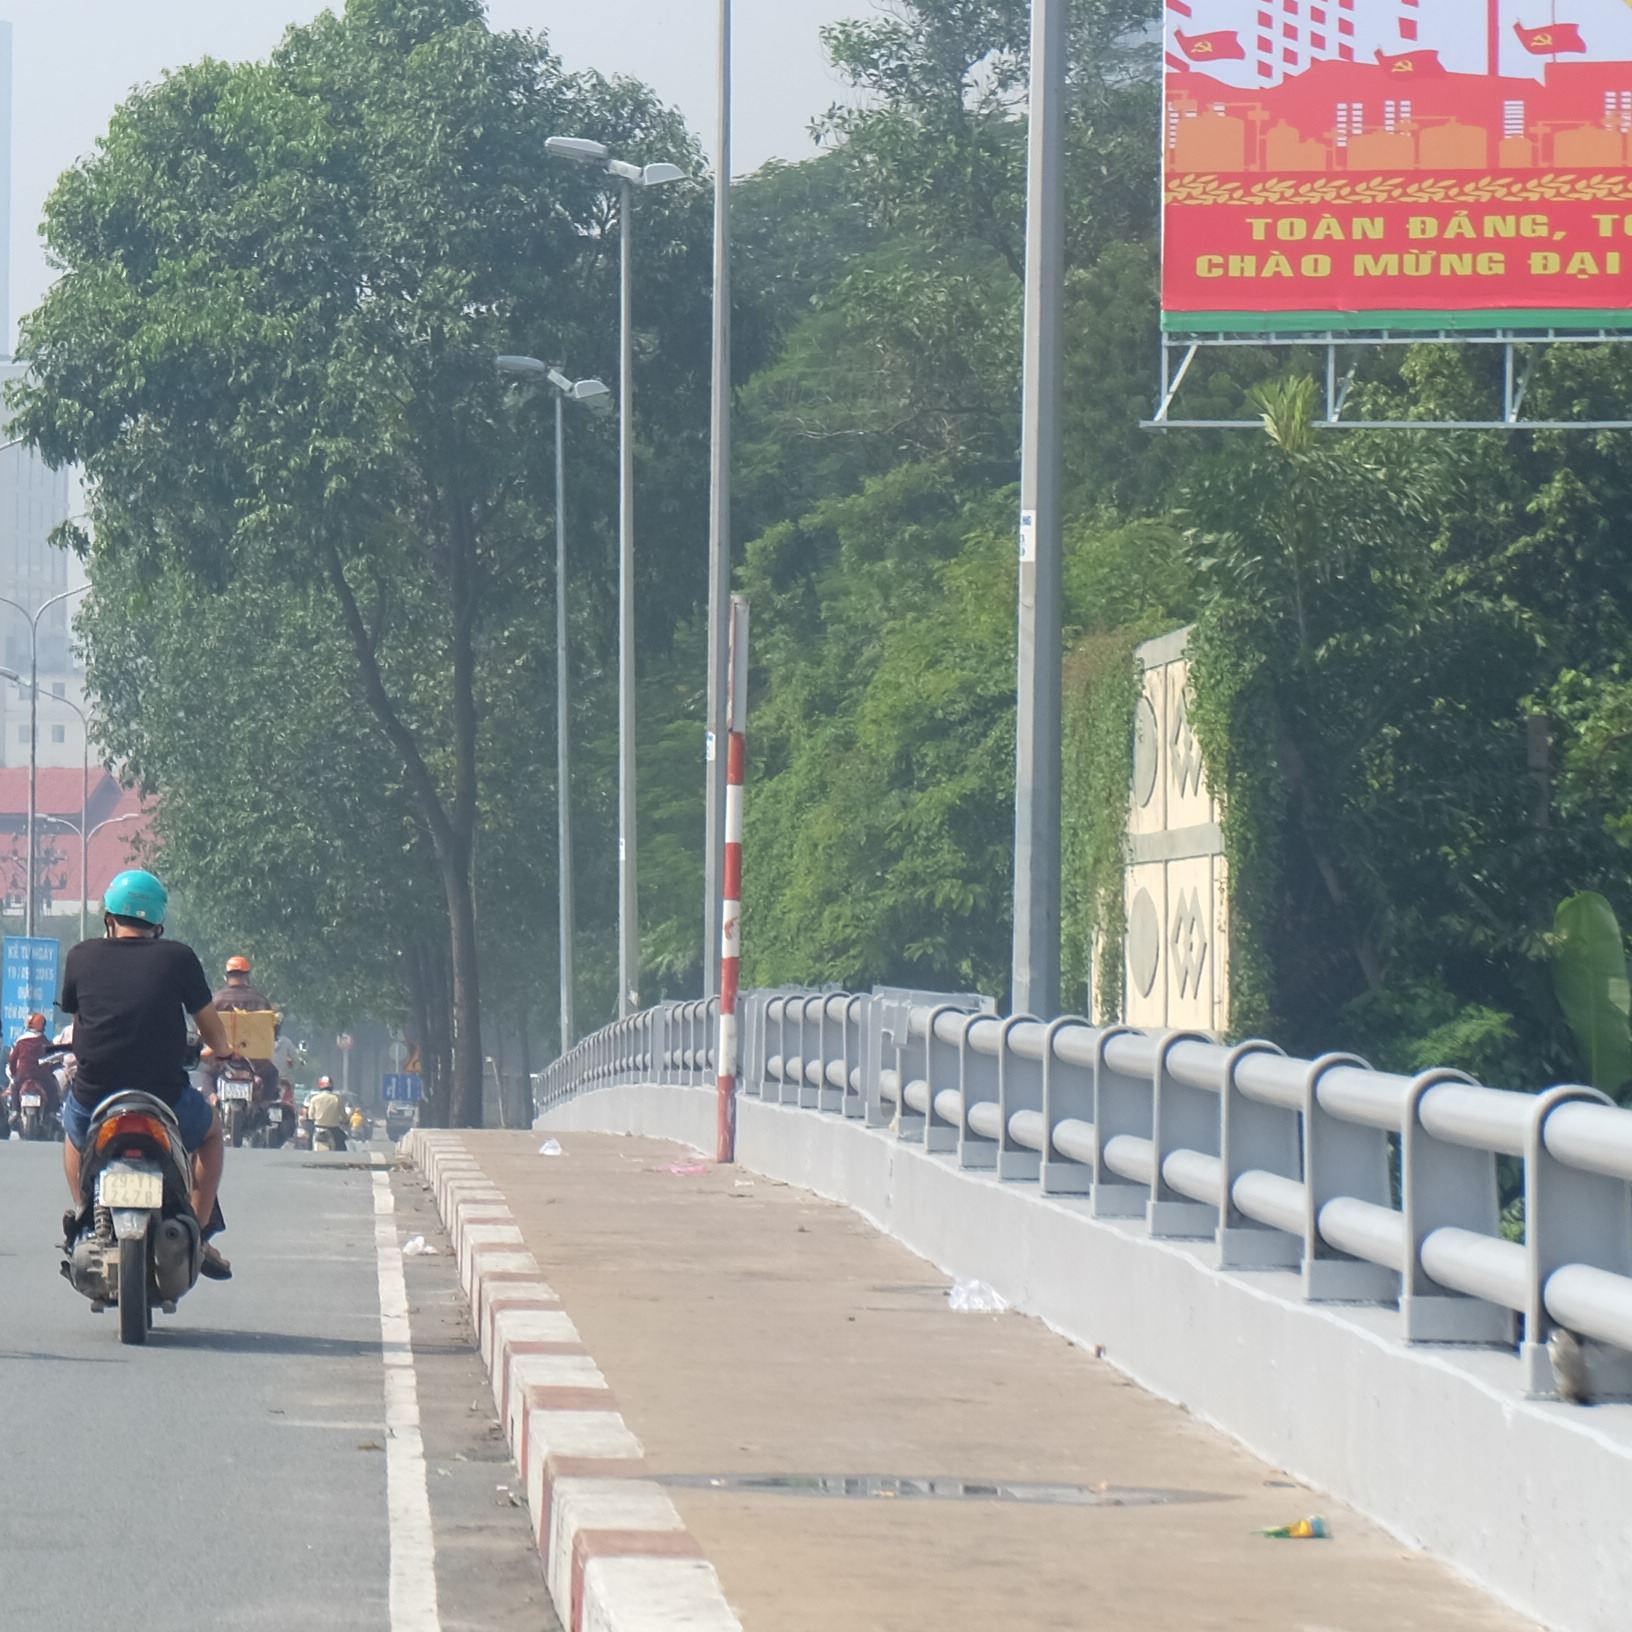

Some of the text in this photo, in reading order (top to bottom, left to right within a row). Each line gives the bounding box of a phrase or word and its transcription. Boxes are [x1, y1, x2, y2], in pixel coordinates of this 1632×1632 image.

[1245, 213, 1385, 241] TOÀN
[1406, 210, 1567, 241] ĐẢNG,
[1195, 249, 1621, 279] CHÀO MỪNG ĐẠI
